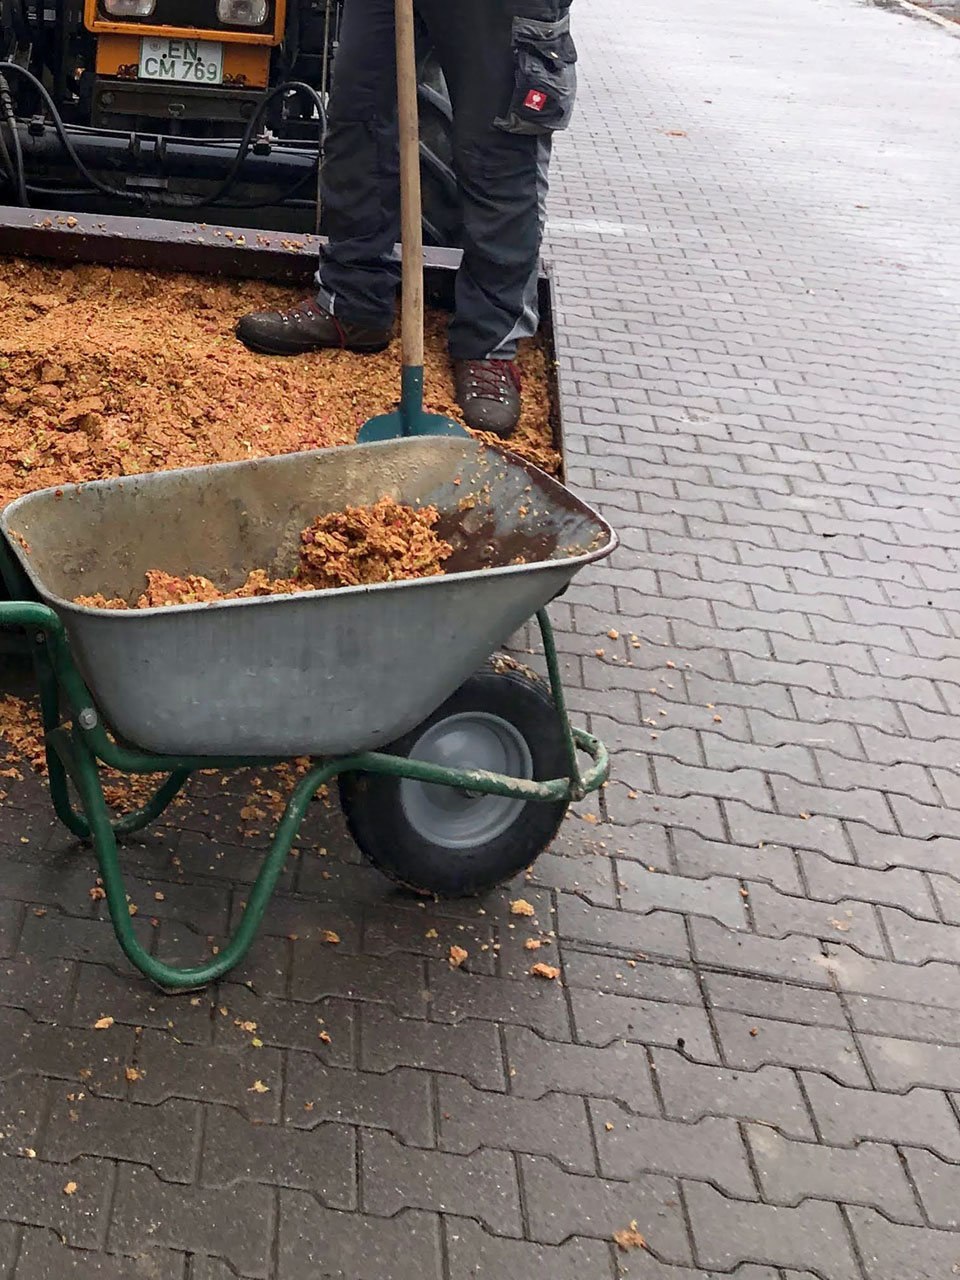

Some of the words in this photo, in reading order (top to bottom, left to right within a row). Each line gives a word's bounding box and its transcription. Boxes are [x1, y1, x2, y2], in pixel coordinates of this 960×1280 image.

[168, 39, 198, 61] EN
[144, 57, 176, 78] CM
[182, 61, 218, 81] 769
